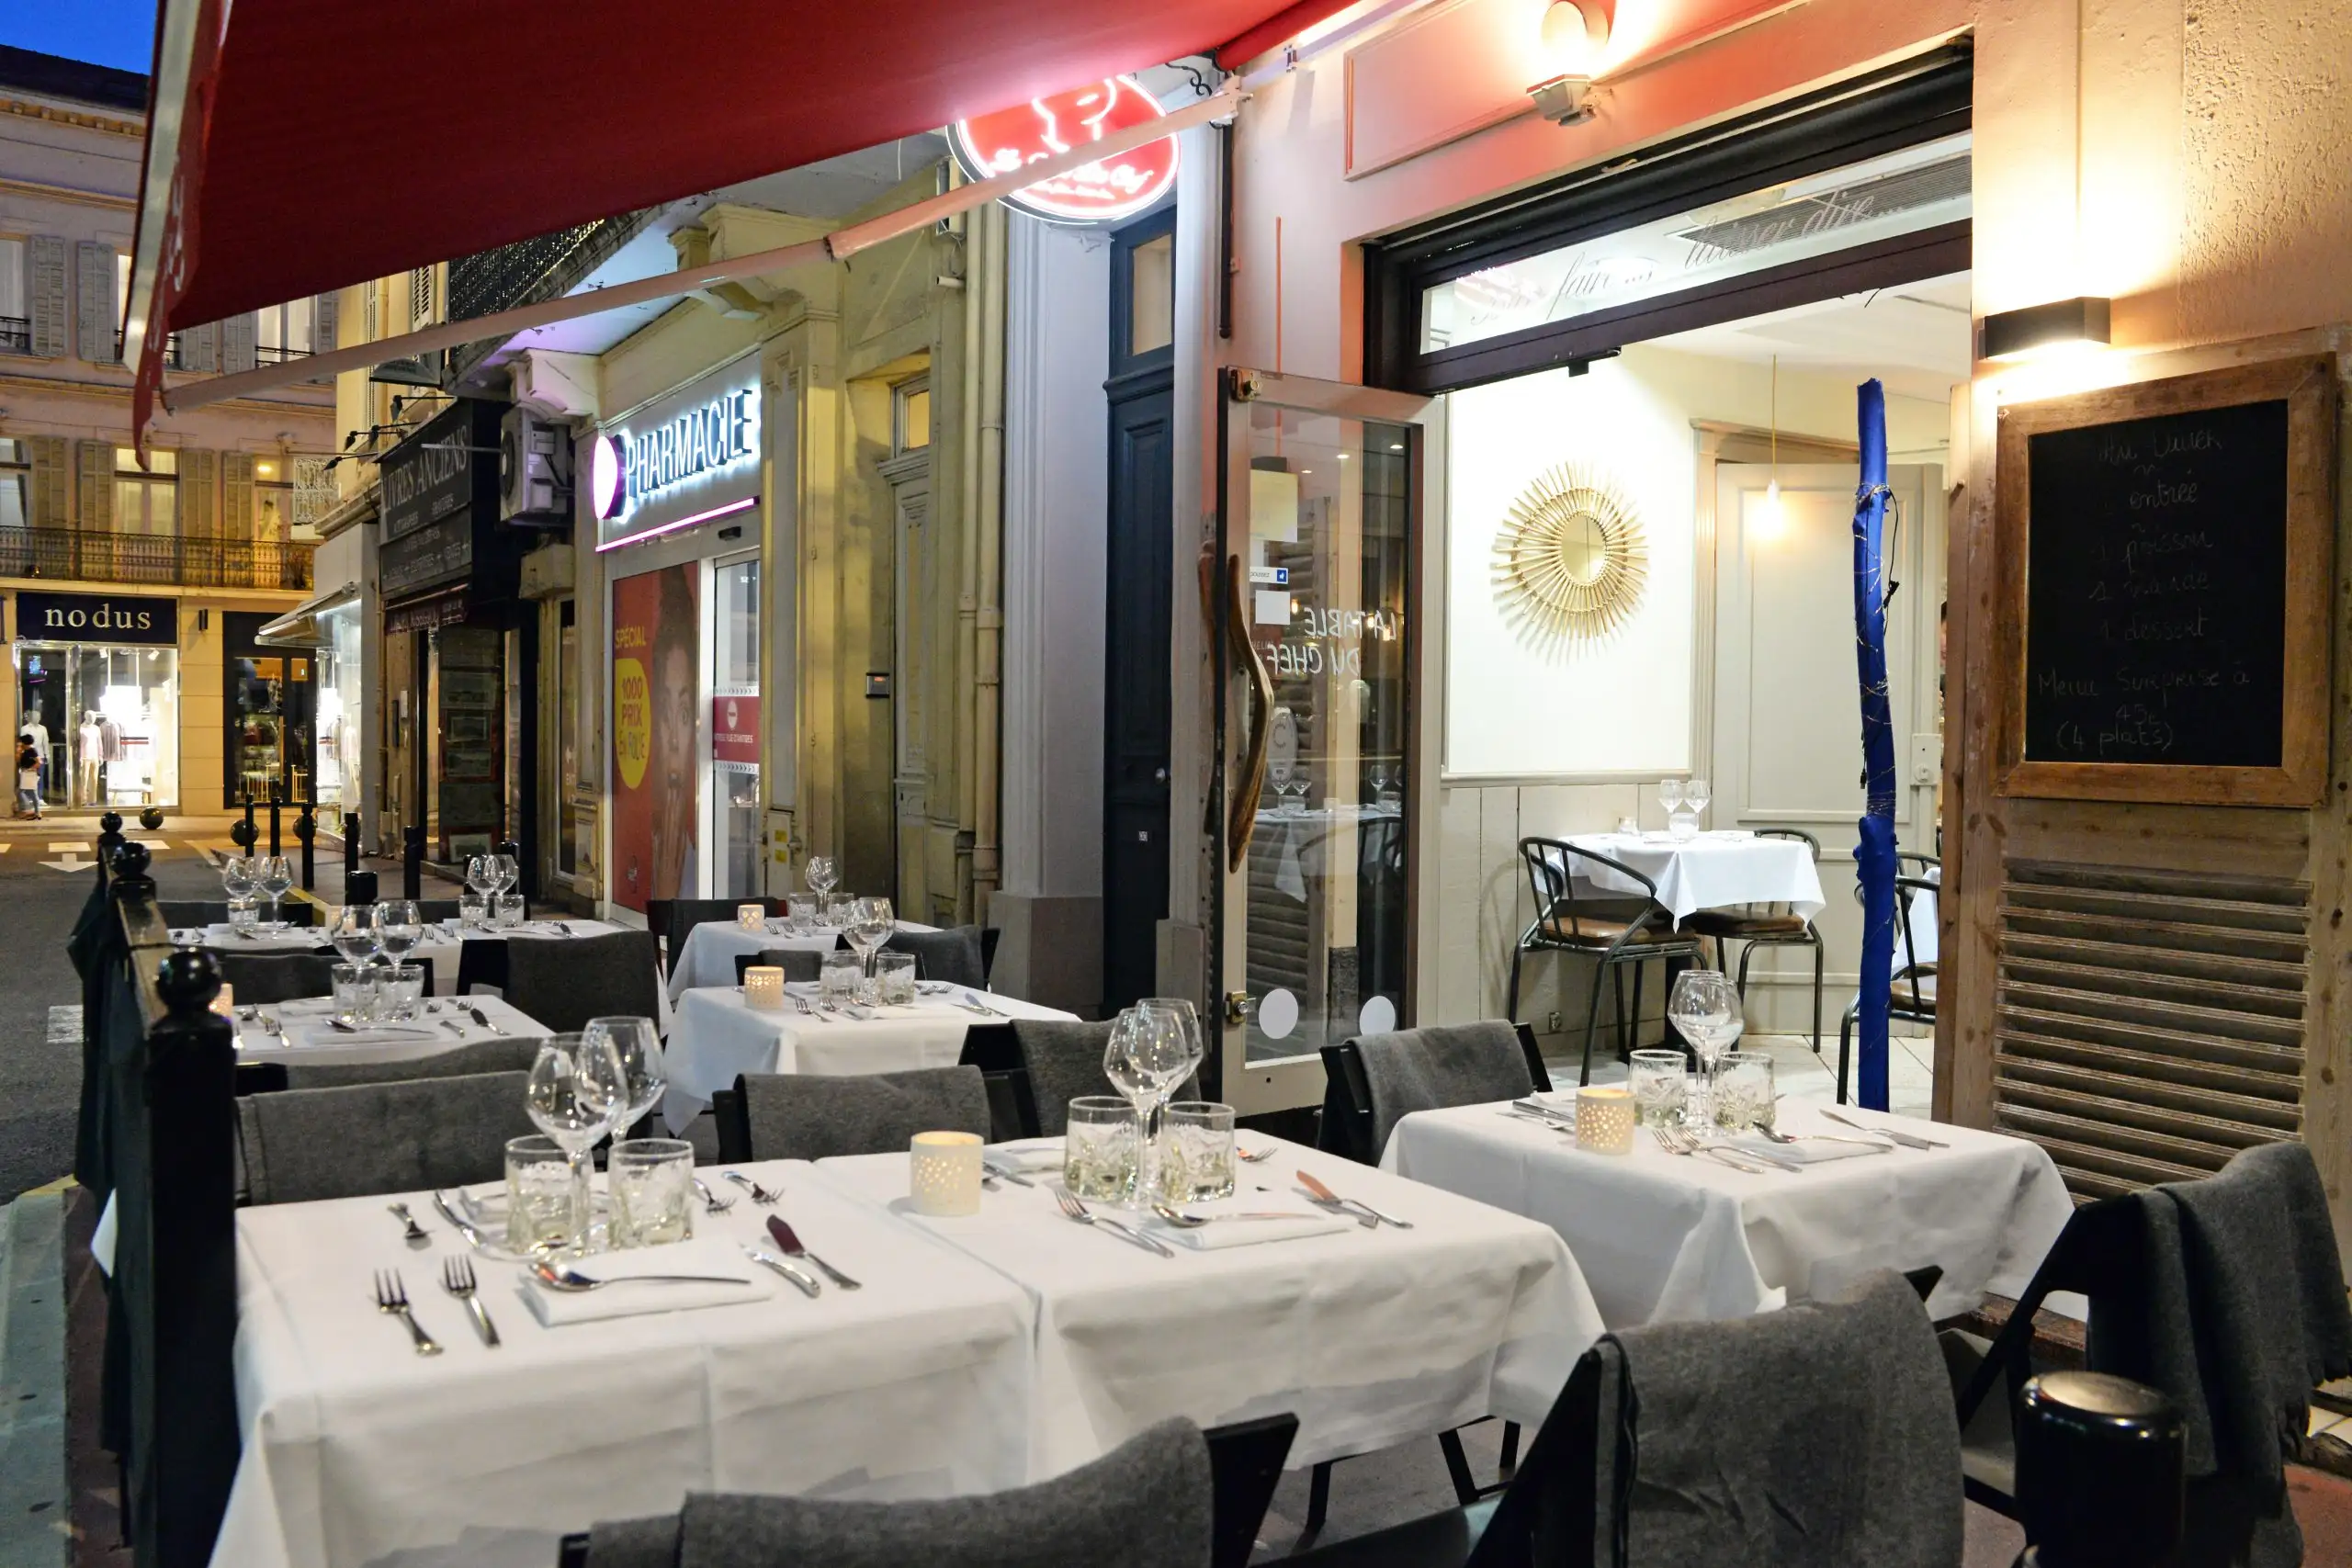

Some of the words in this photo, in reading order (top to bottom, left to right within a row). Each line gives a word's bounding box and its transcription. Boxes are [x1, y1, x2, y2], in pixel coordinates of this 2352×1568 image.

[625, 389, 752, 499] PHARMACIE
[381, 460, 414, 512] LIVRES
[415, 425, 468, 495] ANCIENS
[615, 625, 647, 649] SPÉCIAL
[621, 676, 642, 700] 1000
[621, 703, 642, 728] PRIX
